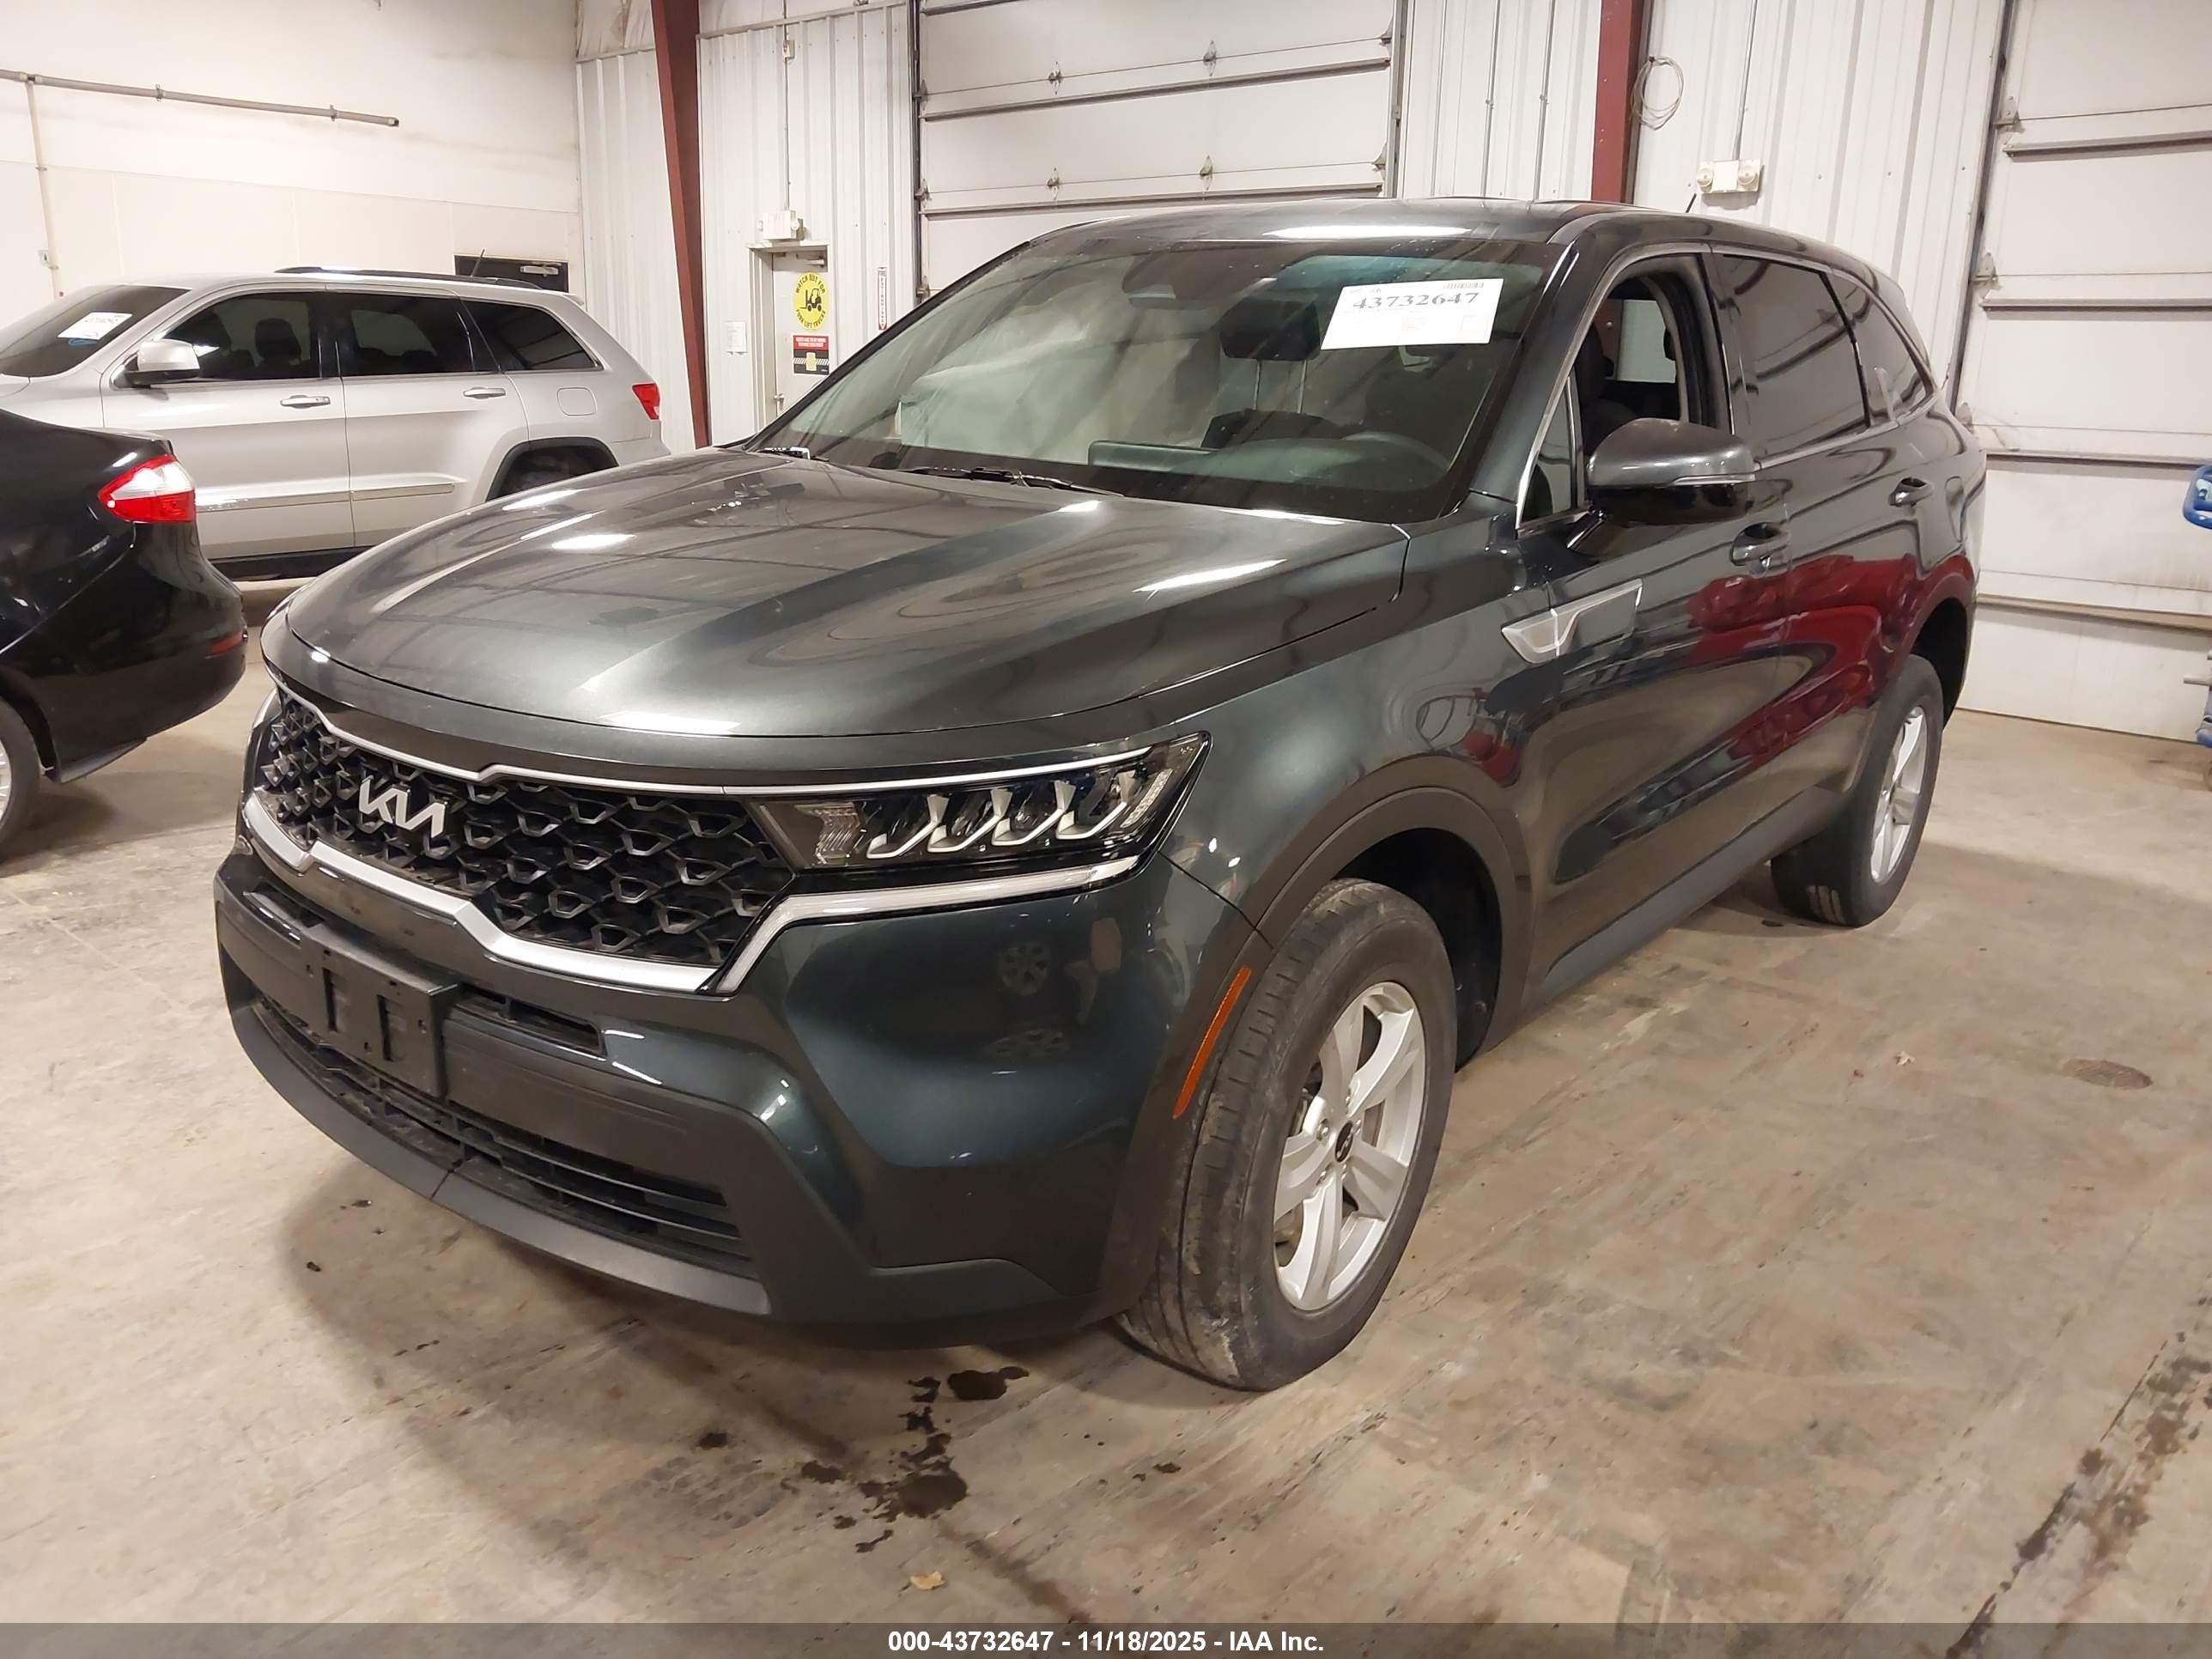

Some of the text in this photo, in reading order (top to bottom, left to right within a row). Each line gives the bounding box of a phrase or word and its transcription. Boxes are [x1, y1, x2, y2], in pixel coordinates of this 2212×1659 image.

[795, 274, 827, 294] WATCH OUT FOR
[1352, 292, 1480, 309] 43732647
[358, 775, 447, 839] KIA
